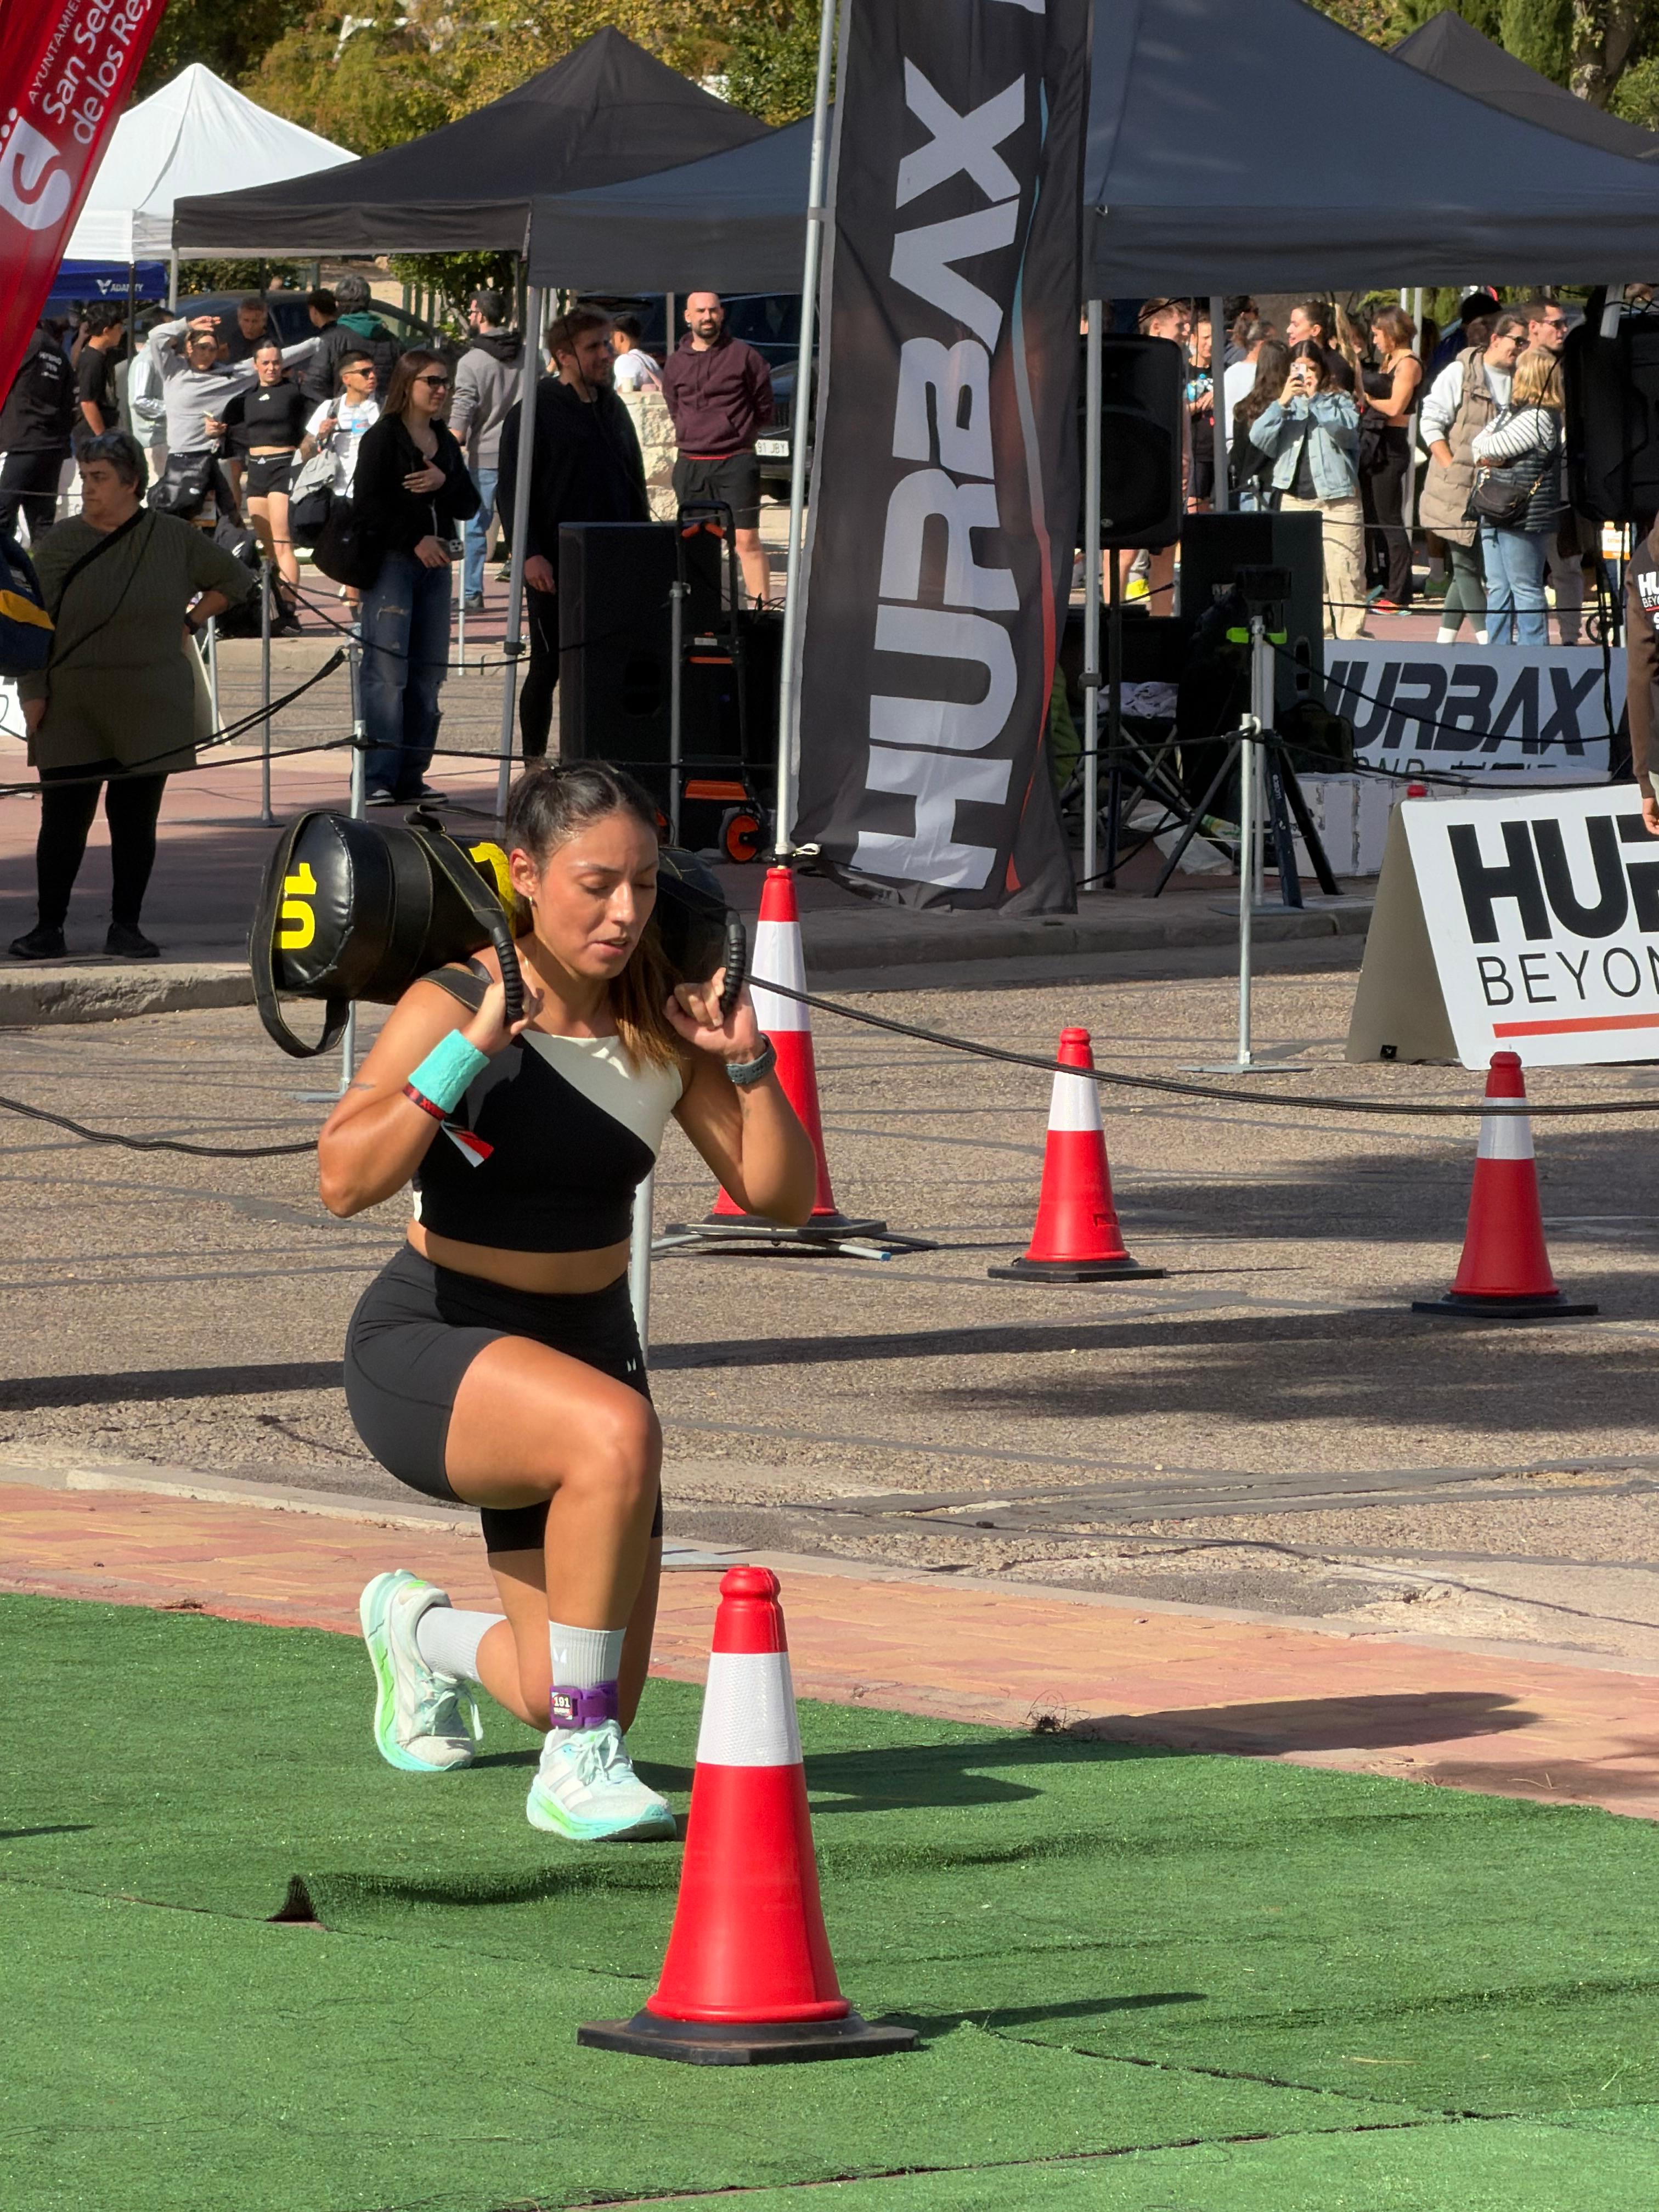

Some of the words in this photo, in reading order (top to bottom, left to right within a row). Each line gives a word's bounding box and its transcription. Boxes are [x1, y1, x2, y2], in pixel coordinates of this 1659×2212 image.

[110, 0, 151, 46] Re
[29, 0, 81, 104] AYUNTAMIE
[86, 44, 124, 97] los
[43, 57, 86, 124] San
[72, 97, 104, 144] de
[850, 57, 1025, 890] HURBAX
[1642, 595, 1659, 608] BEY
[554, 1696, 571, 1707] 191
